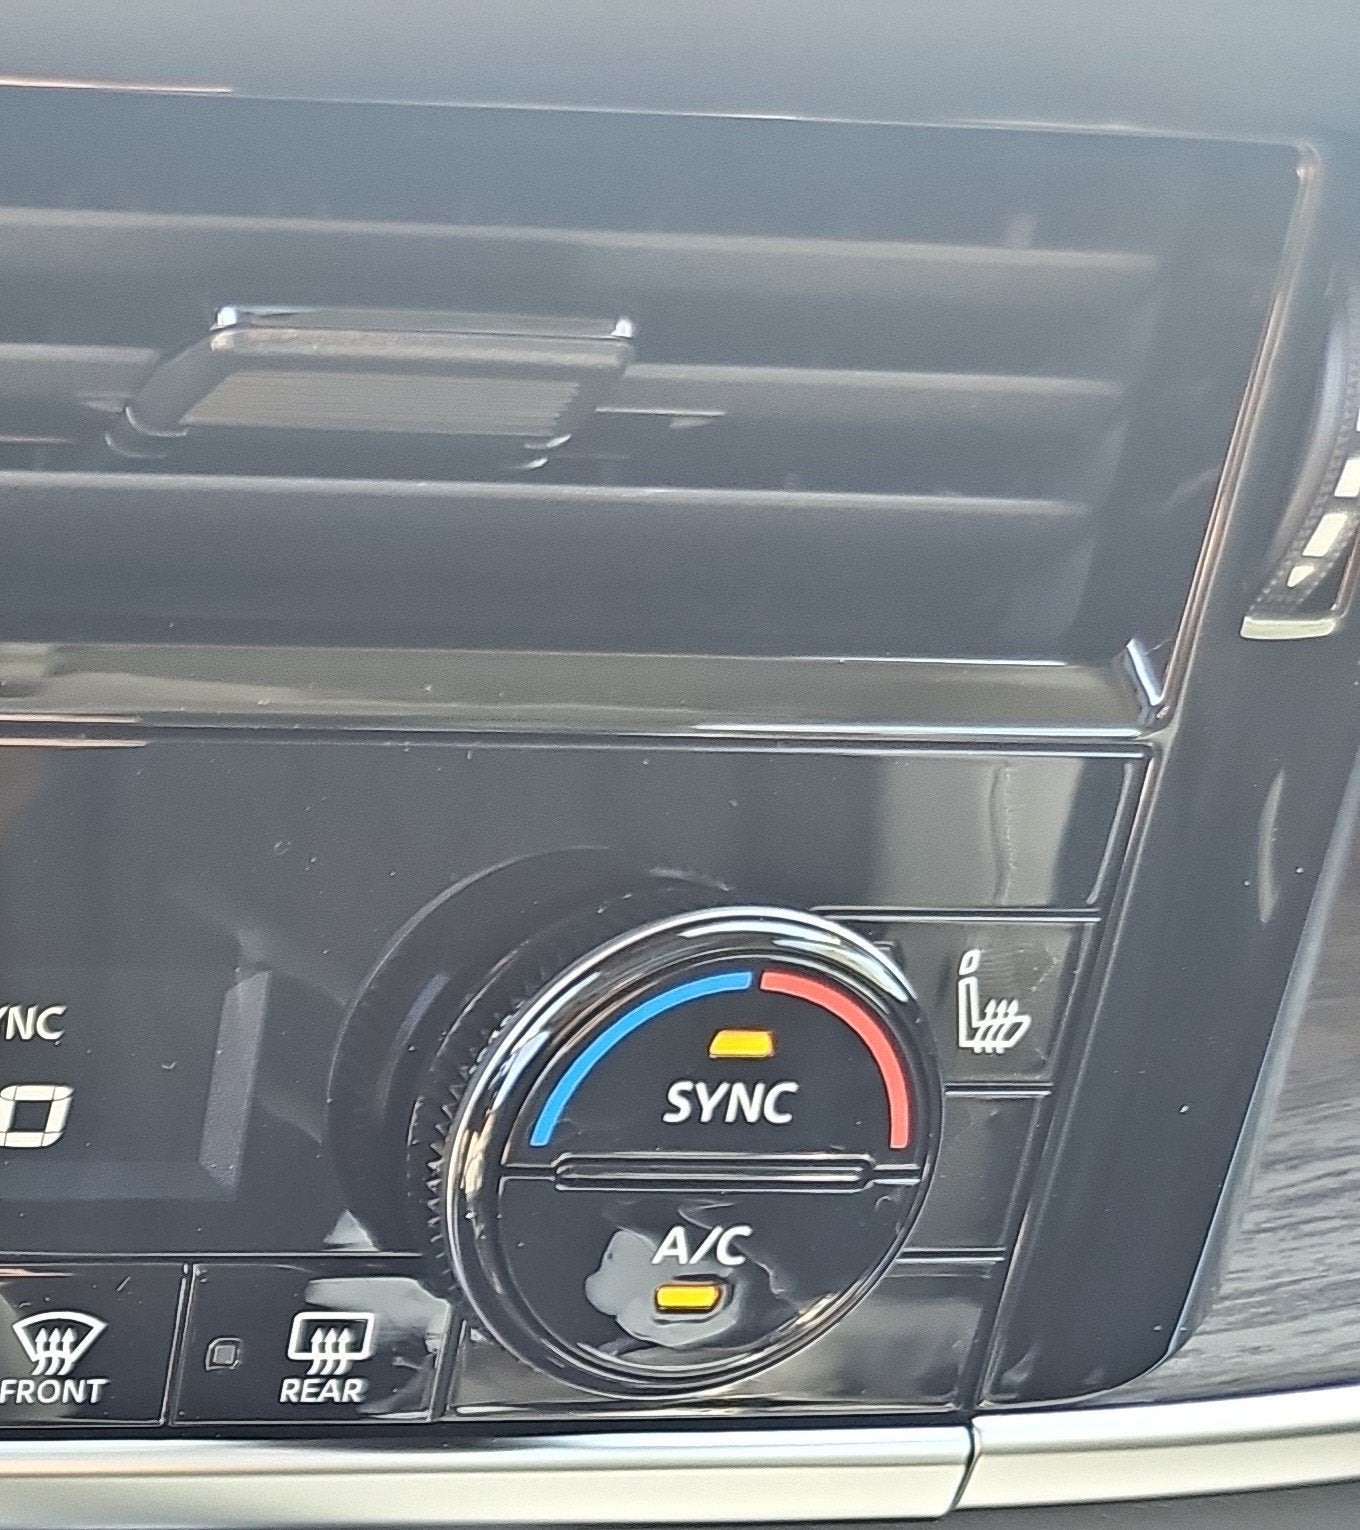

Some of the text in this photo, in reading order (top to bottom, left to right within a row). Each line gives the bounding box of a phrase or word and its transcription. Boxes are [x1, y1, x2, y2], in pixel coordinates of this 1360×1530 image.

[662, 1080, 799, 1125] SYNC
[652, 1225, 754, 1266] A/C
[279, 1377, 364, 1405] REAR
